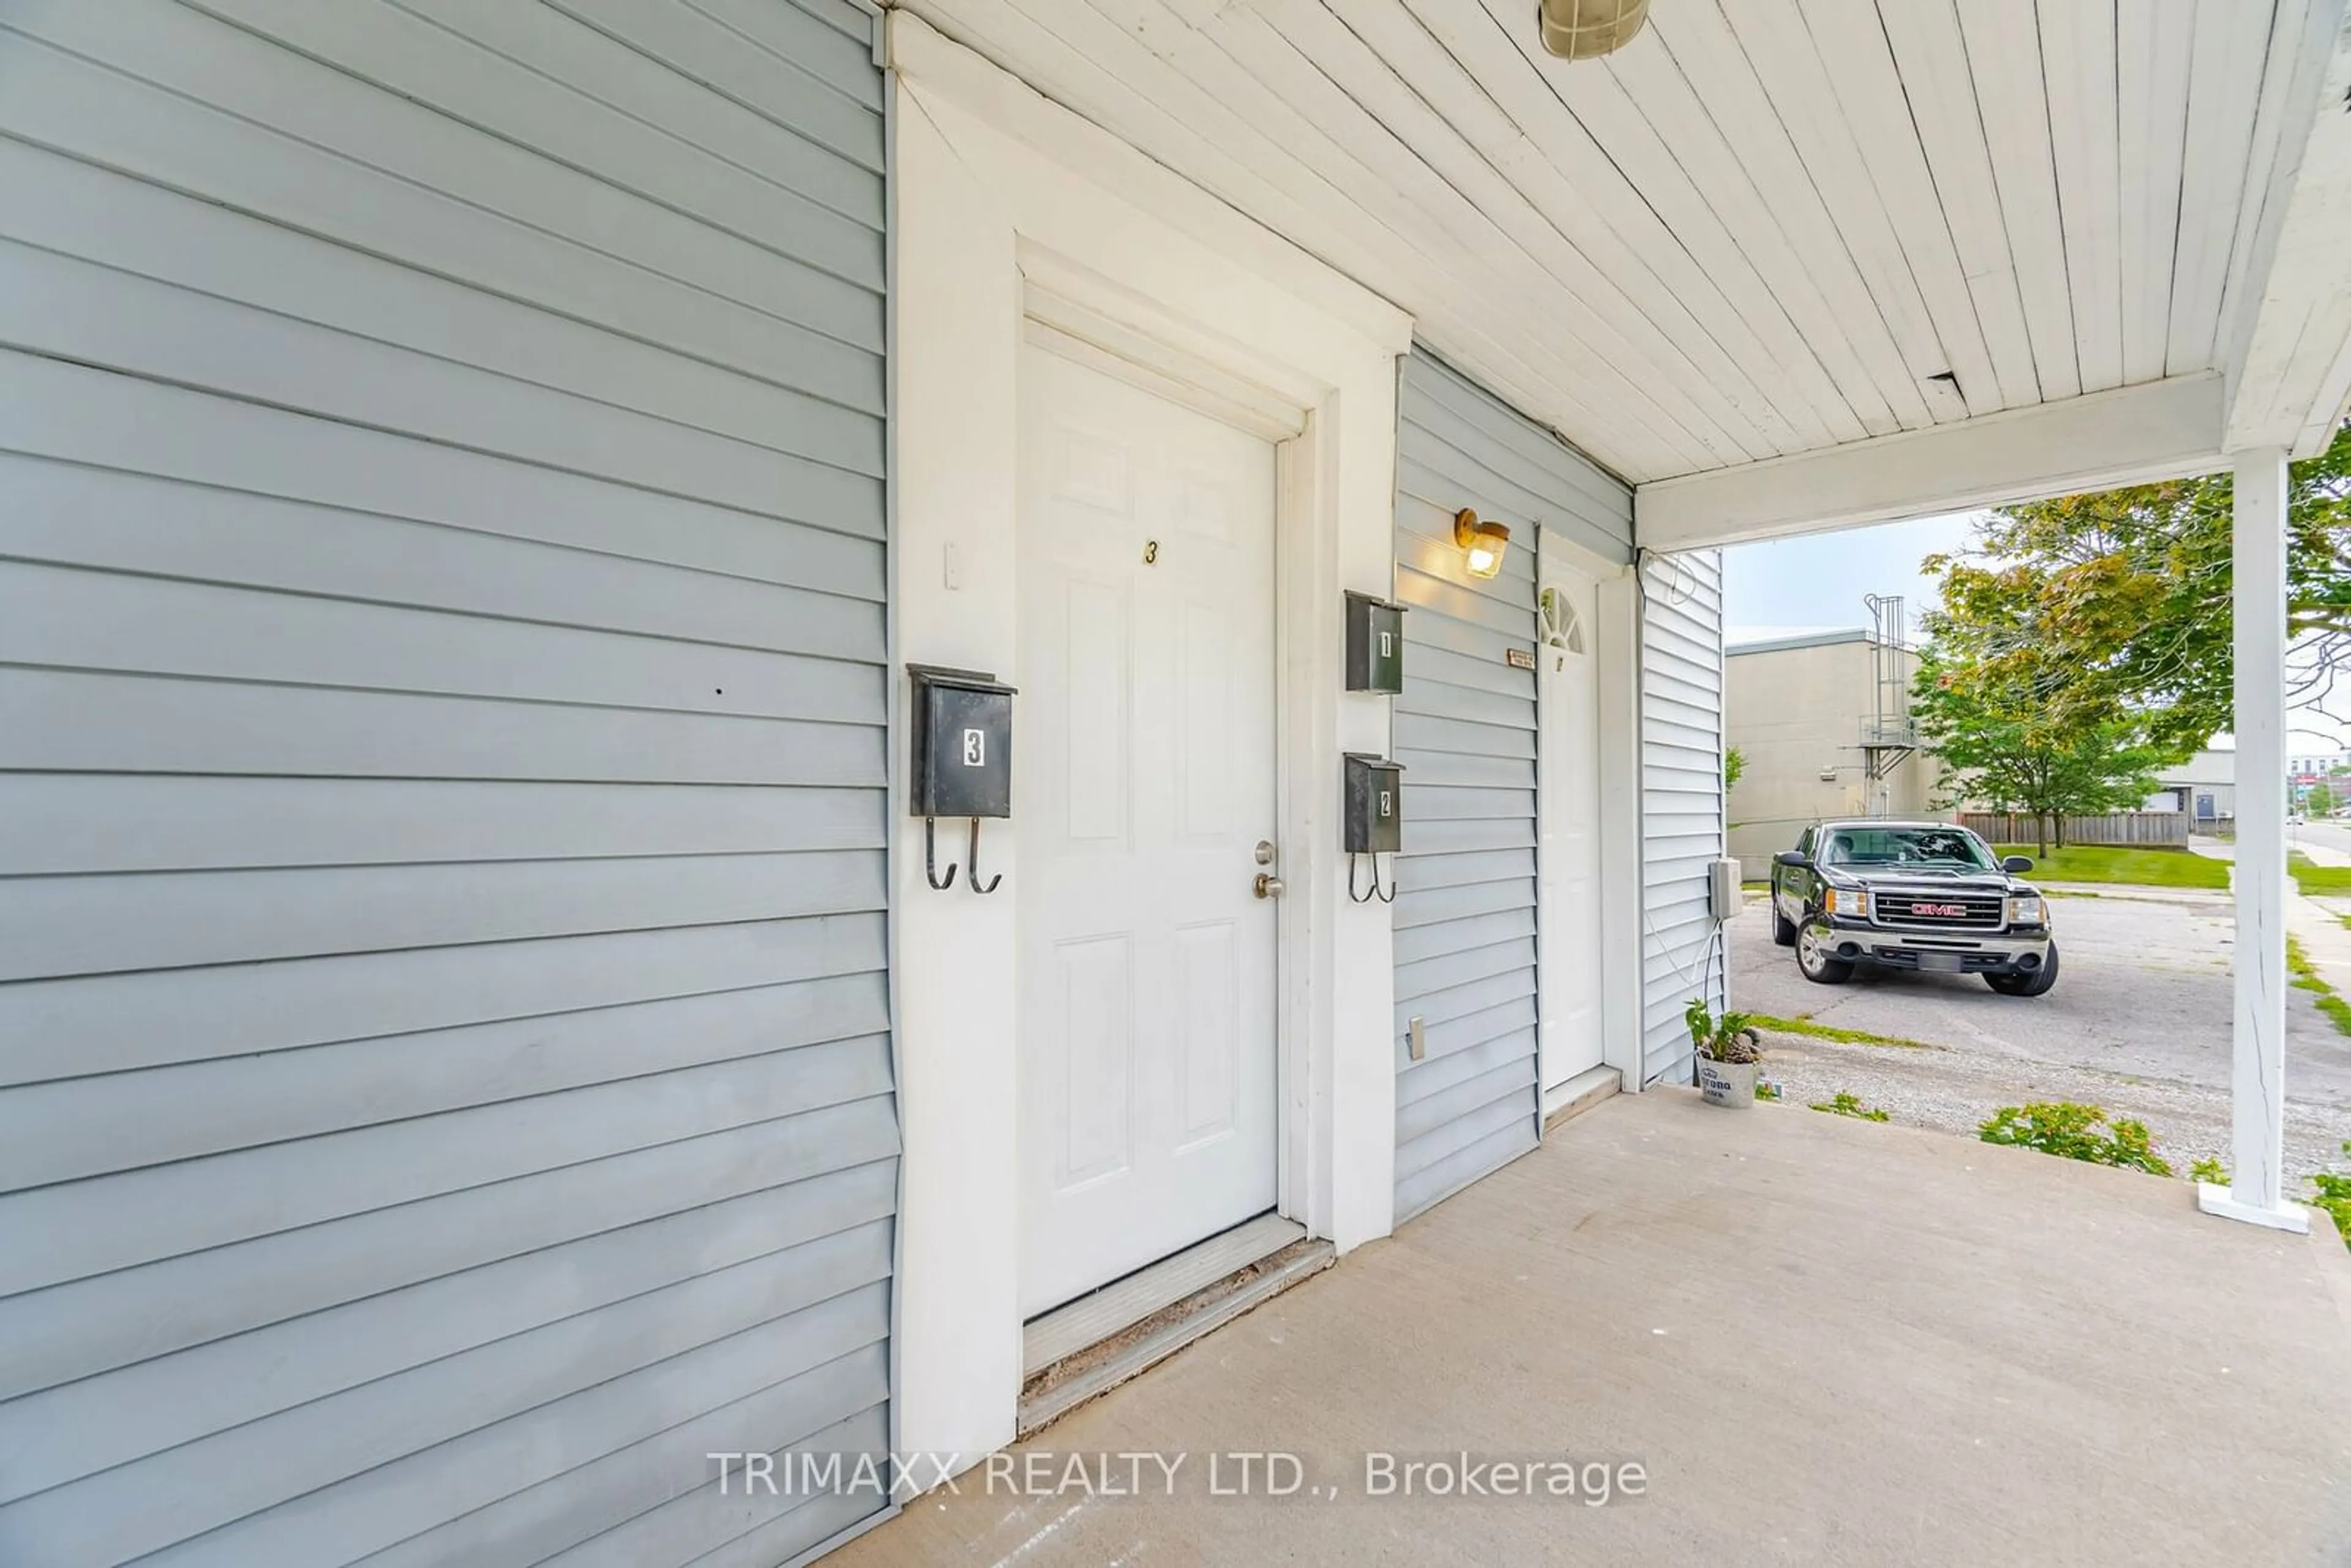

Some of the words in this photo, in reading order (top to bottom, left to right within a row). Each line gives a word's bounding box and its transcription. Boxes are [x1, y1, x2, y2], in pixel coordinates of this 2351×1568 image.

[1146, 541, 1157, 563] 3
[968, 732, 981, 763] 3
[1383, 793, 1389, 814] 2
[1911, 904, 1967, 916] GMC
